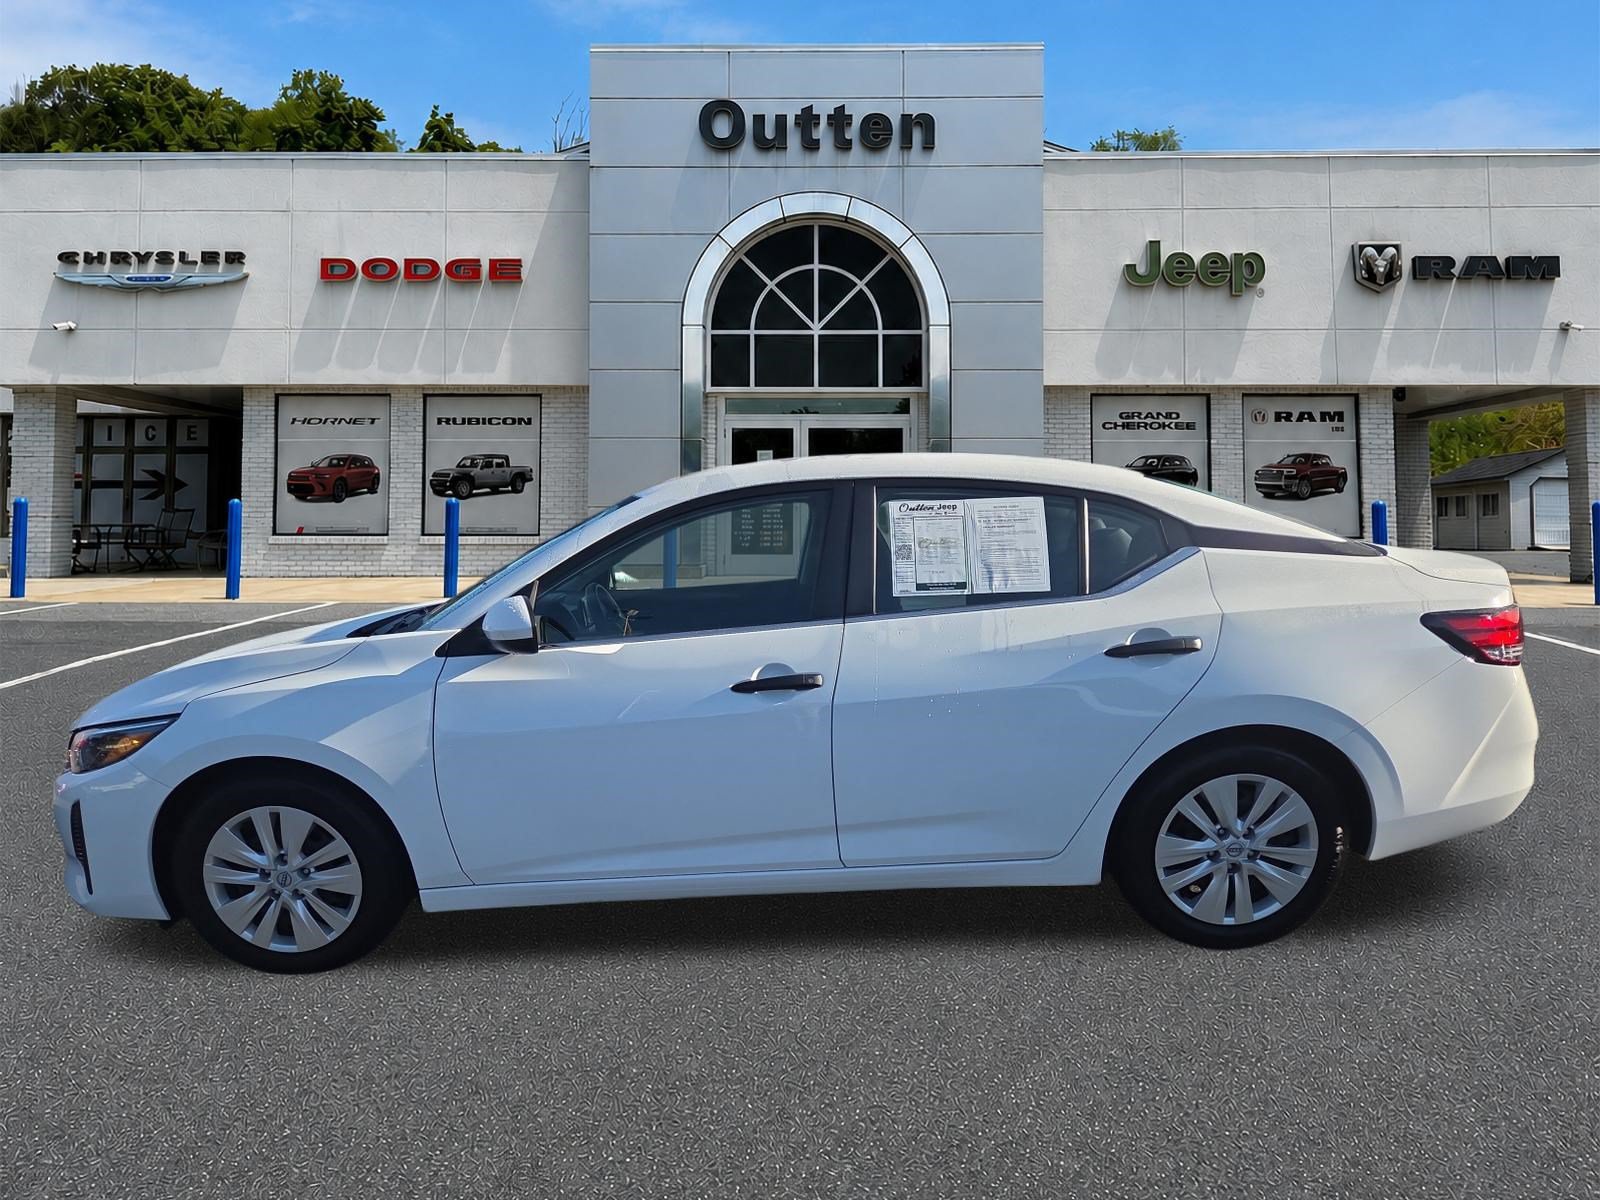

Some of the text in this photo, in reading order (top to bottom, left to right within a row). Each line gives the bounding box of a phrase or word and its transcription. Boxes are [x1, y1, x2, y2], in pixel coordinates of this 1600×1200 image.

[699, 99, 936, 151] Outten
[57, 250, 247, 266] CHRYSLER
[320, 257, 523, 282] DODGE
[1123, 239, 1266, 297] Jeep
[1411, 255, 1561, 280] RAM
[290, 417, 381, 426] HORNET
[436, 417, 533, 426] RUBICON
[1118, 411, 1181, 421] GRAND
[1274, 411, 1345, 422] RAM
[1101, 421, 1197, 431] CHEROKEE
[898, 503, 935, 513] Outten
[937, 503, 958, 511] Jeep
